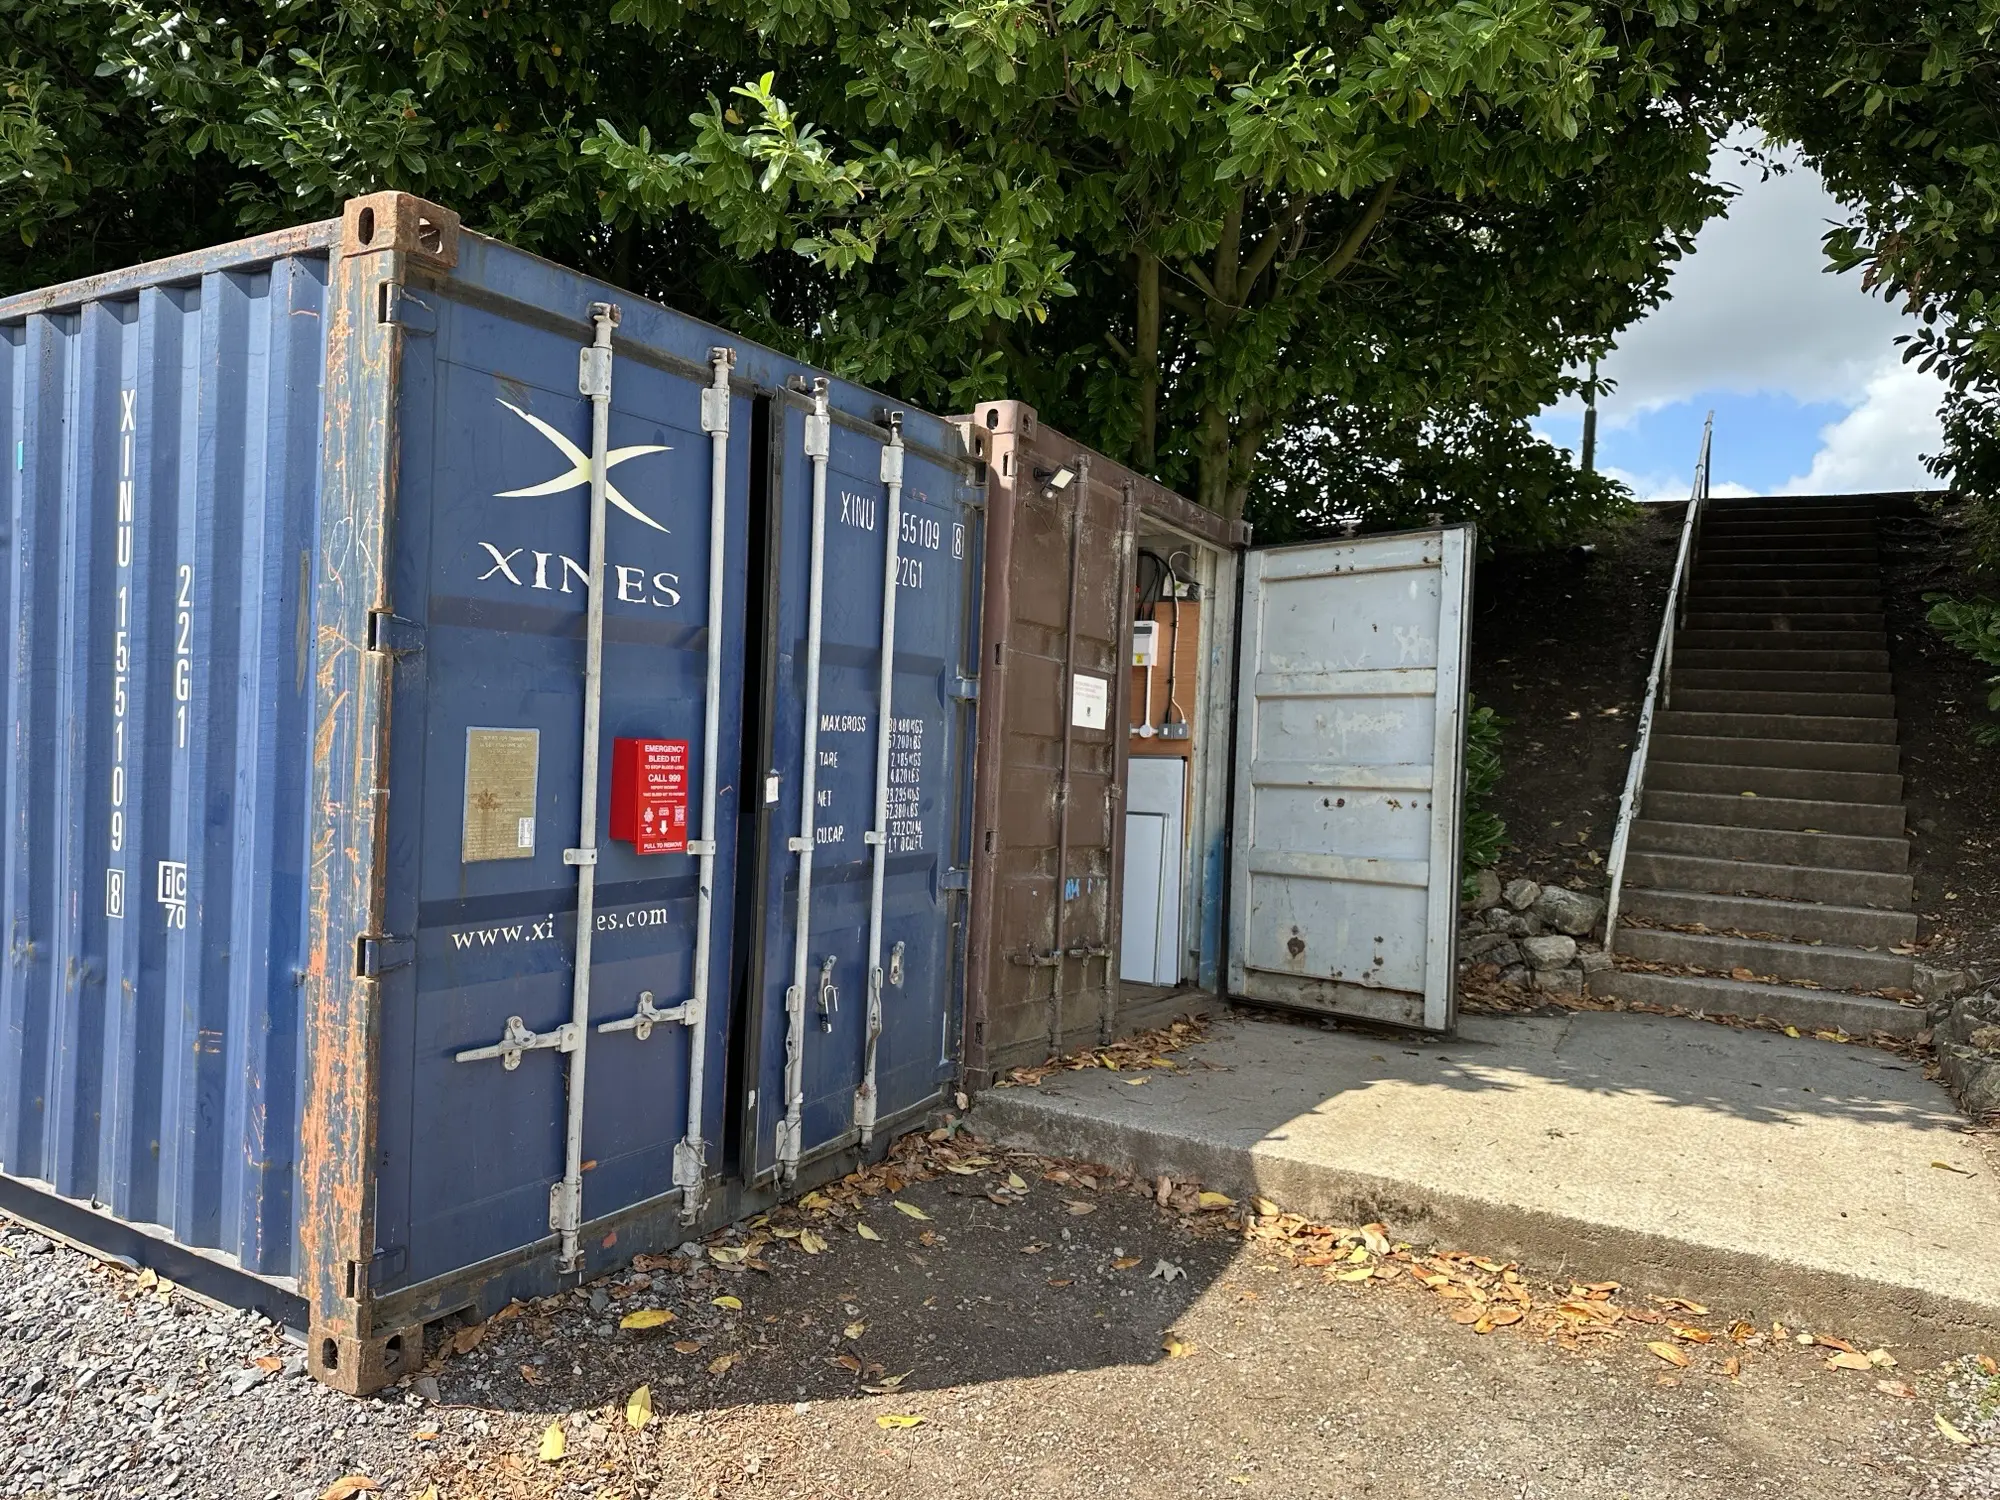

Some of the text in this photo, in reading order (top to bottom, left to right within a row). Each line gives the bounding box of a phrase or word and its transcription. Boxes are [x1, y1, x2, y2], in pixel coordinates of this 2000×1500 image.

[841, 491, 875, 531] XINU
[110, 389, 135, 914] XINU 155109 8
[176, 565, 192, 748] 22G1
[819, 751, 838, 768] TARE
[648, 774, 681, 782] CALL 999
[817, 790, 832, 807] NET
[164, 904, 186, 930] 70
[451, 907, 668, 951] www.xies.com
